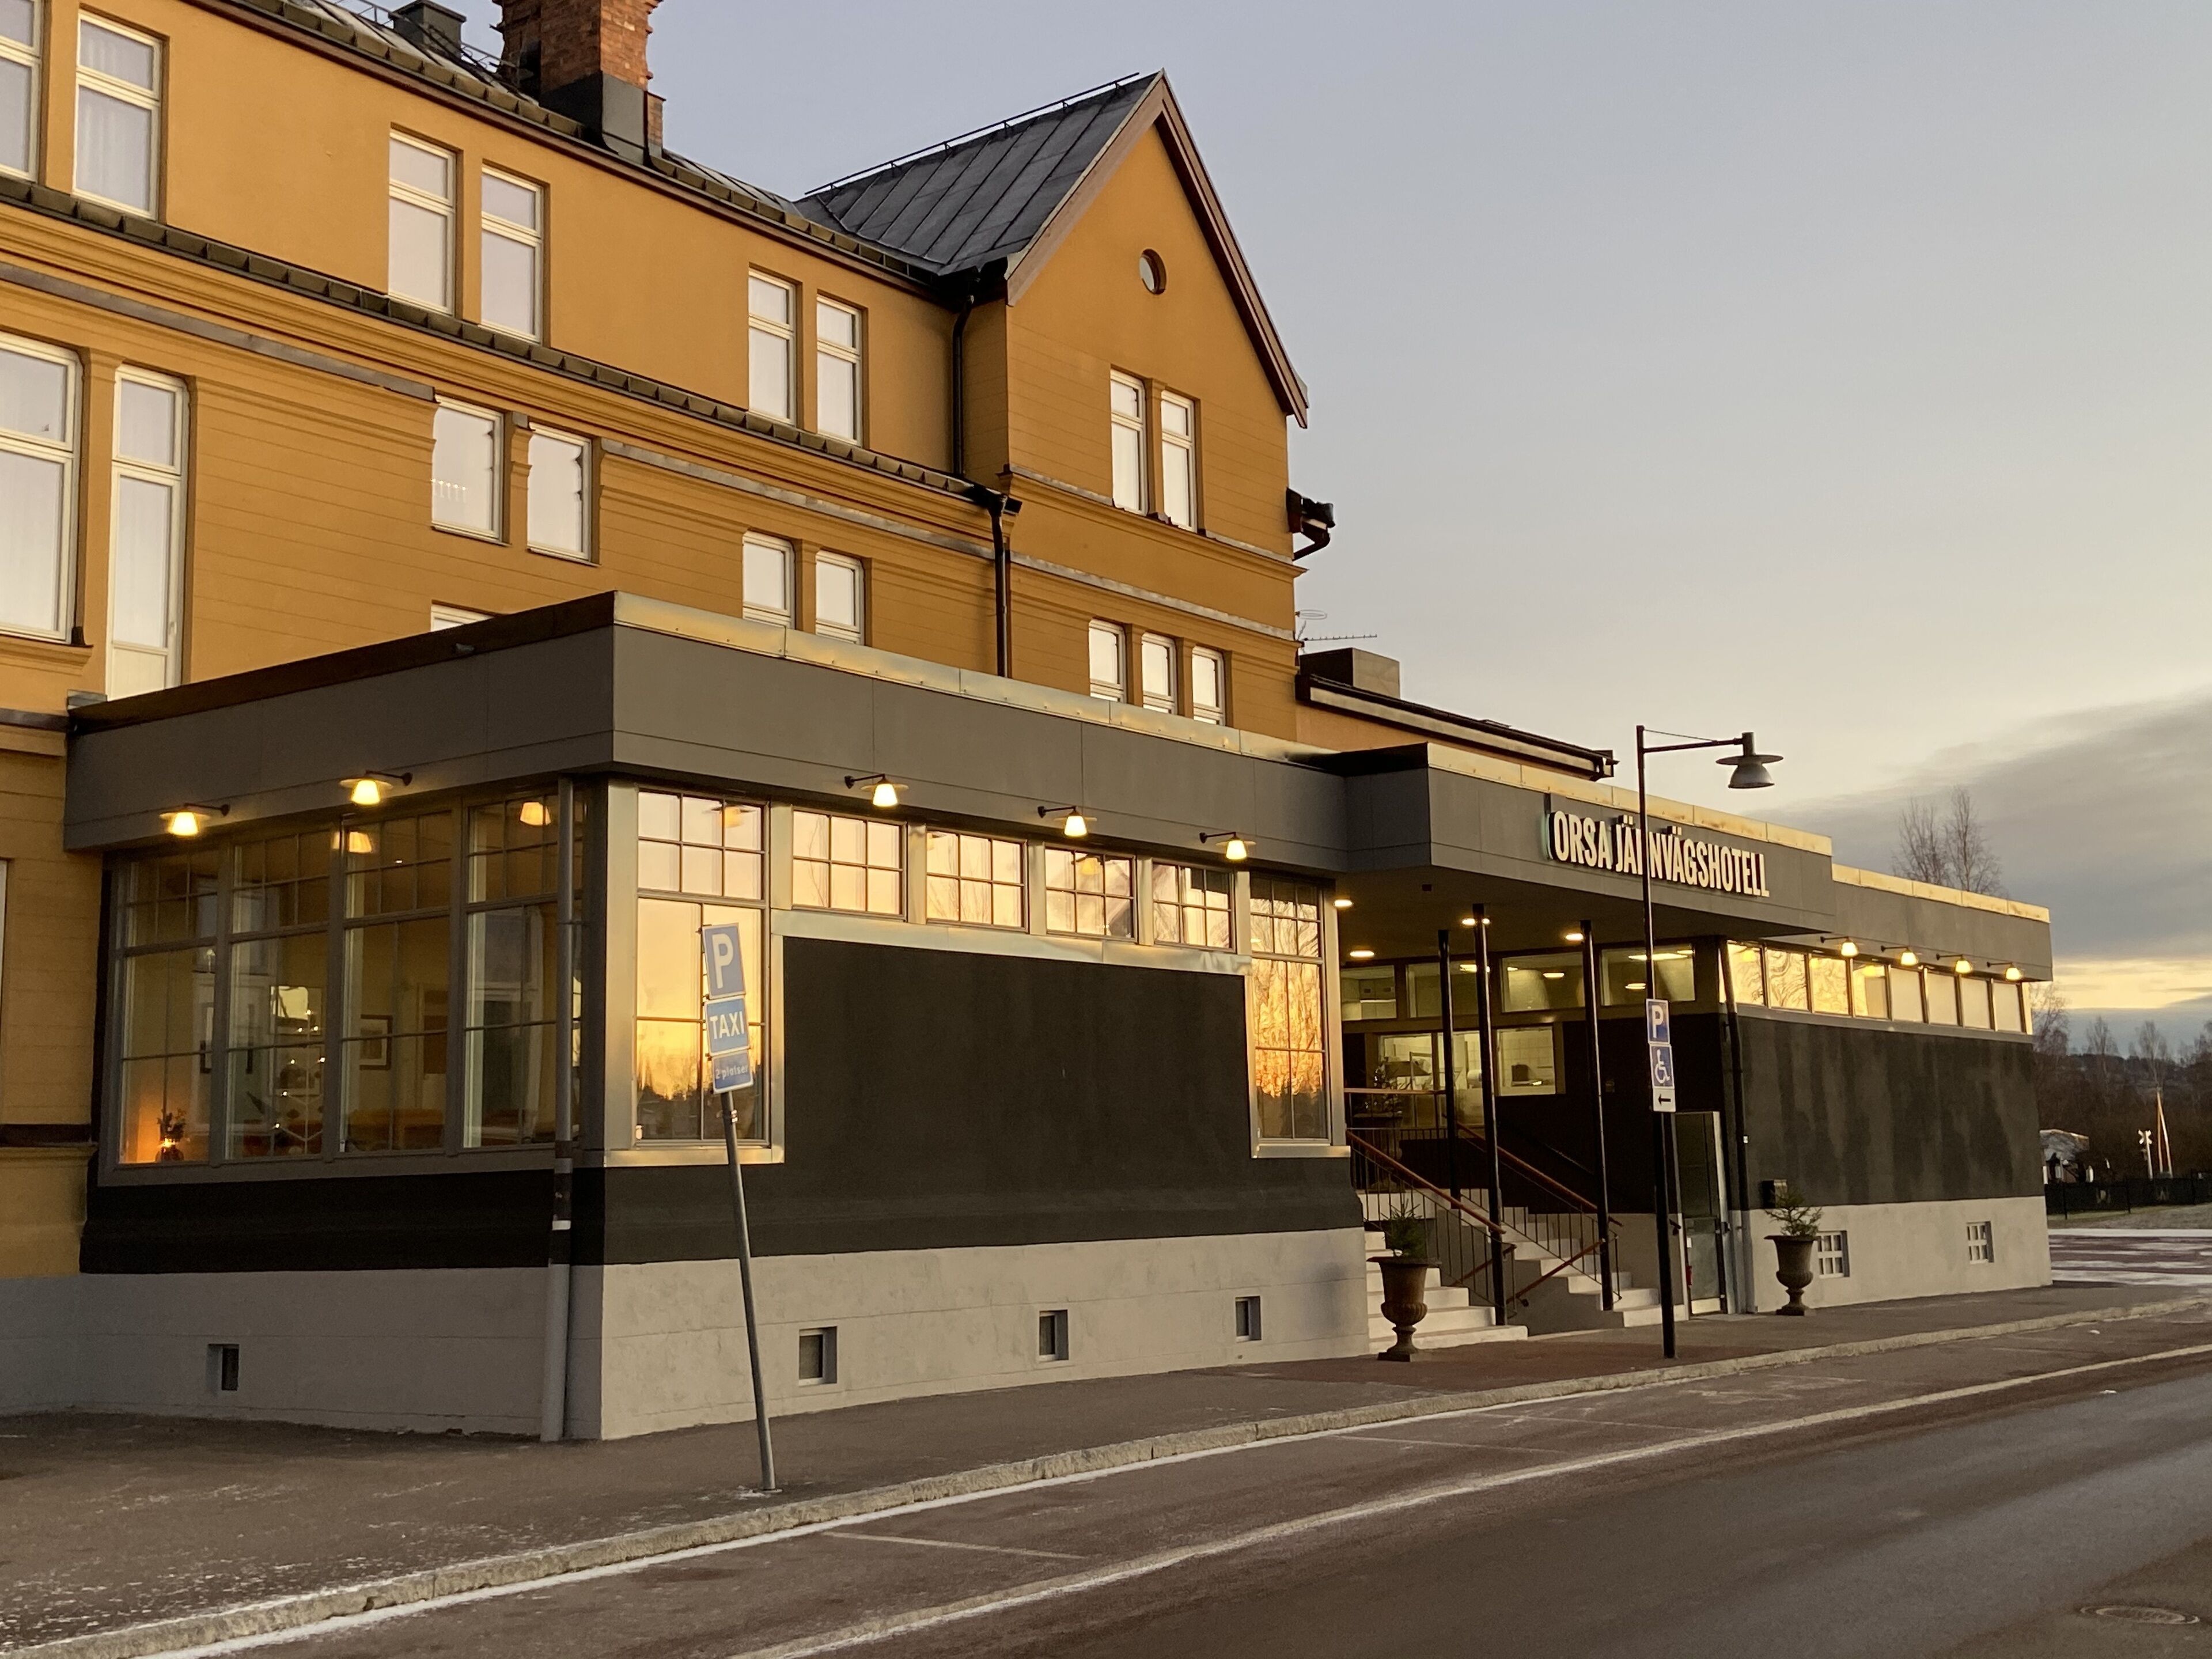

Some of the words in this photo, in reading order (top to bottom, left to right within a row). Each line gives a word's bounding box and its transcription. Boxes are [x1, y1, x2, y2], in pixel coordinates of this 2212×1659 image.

[1552, 810, 1613, 869] ORSA
[712, 933, 734, 989] P
[710, 1011, 745, 1040] TAXI
[1652, 1005, 1664, 1038] P
[715, 1068, 720, 1080] 2
